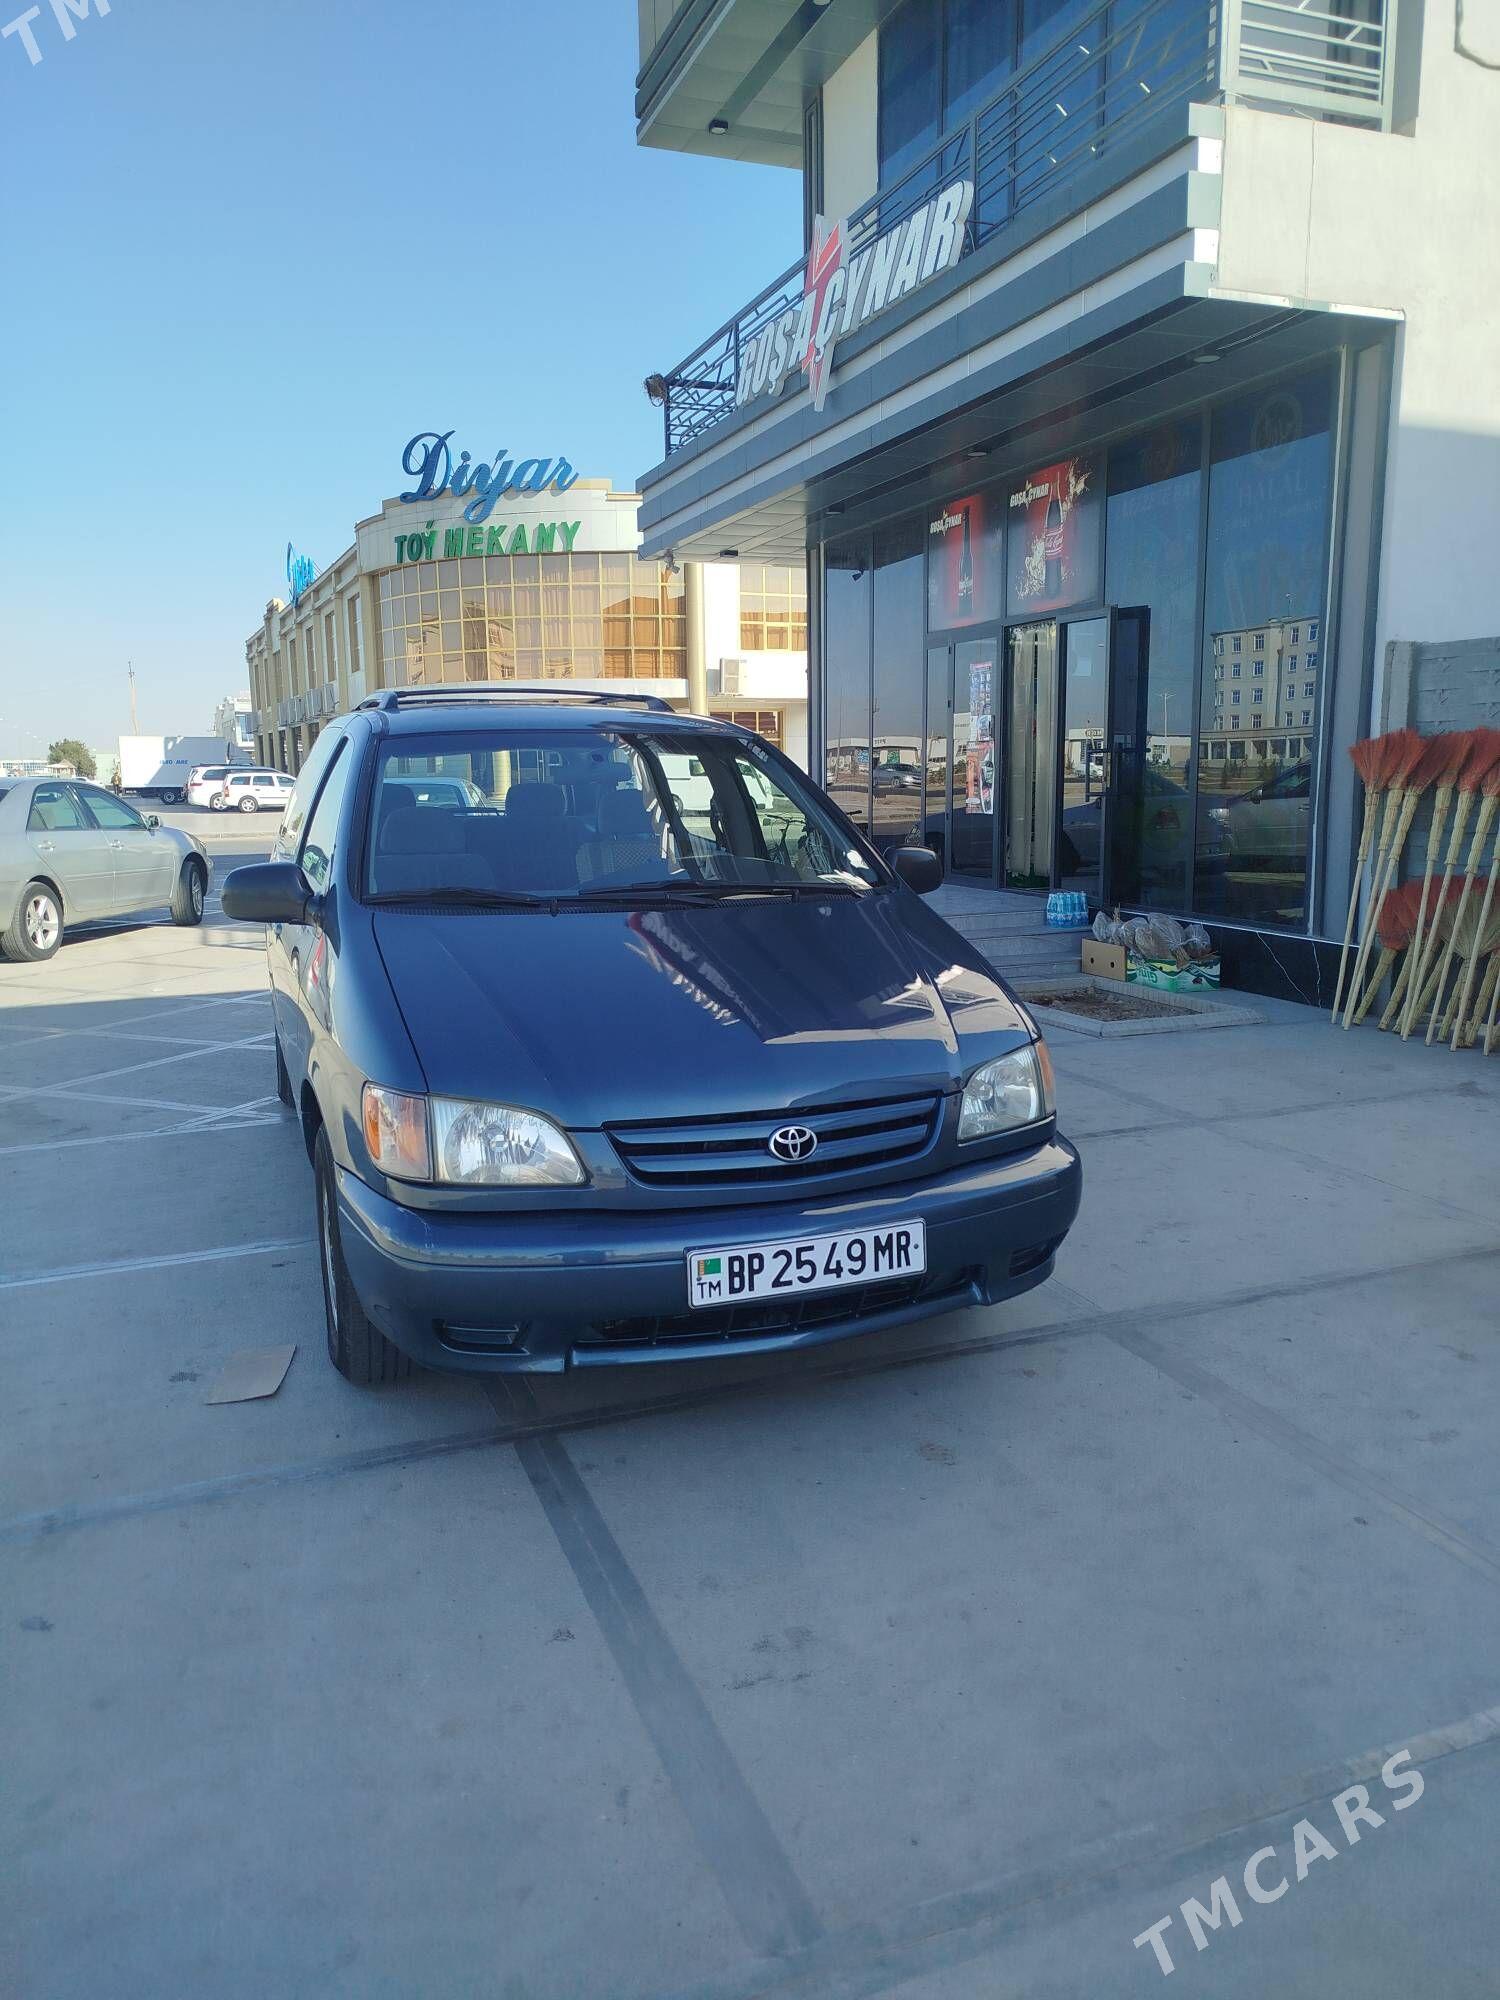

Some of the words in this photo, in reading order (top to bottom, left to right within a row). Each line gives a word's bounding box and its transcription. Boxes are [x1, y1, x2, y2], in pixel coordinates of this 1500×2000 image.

[815, 180, 974, 364] ÇYNAR
[394, 520, 438, 564] TOÝ
[443, 520, 582, 558] MEKANY
[696, 1280, 722, 1299] TM
